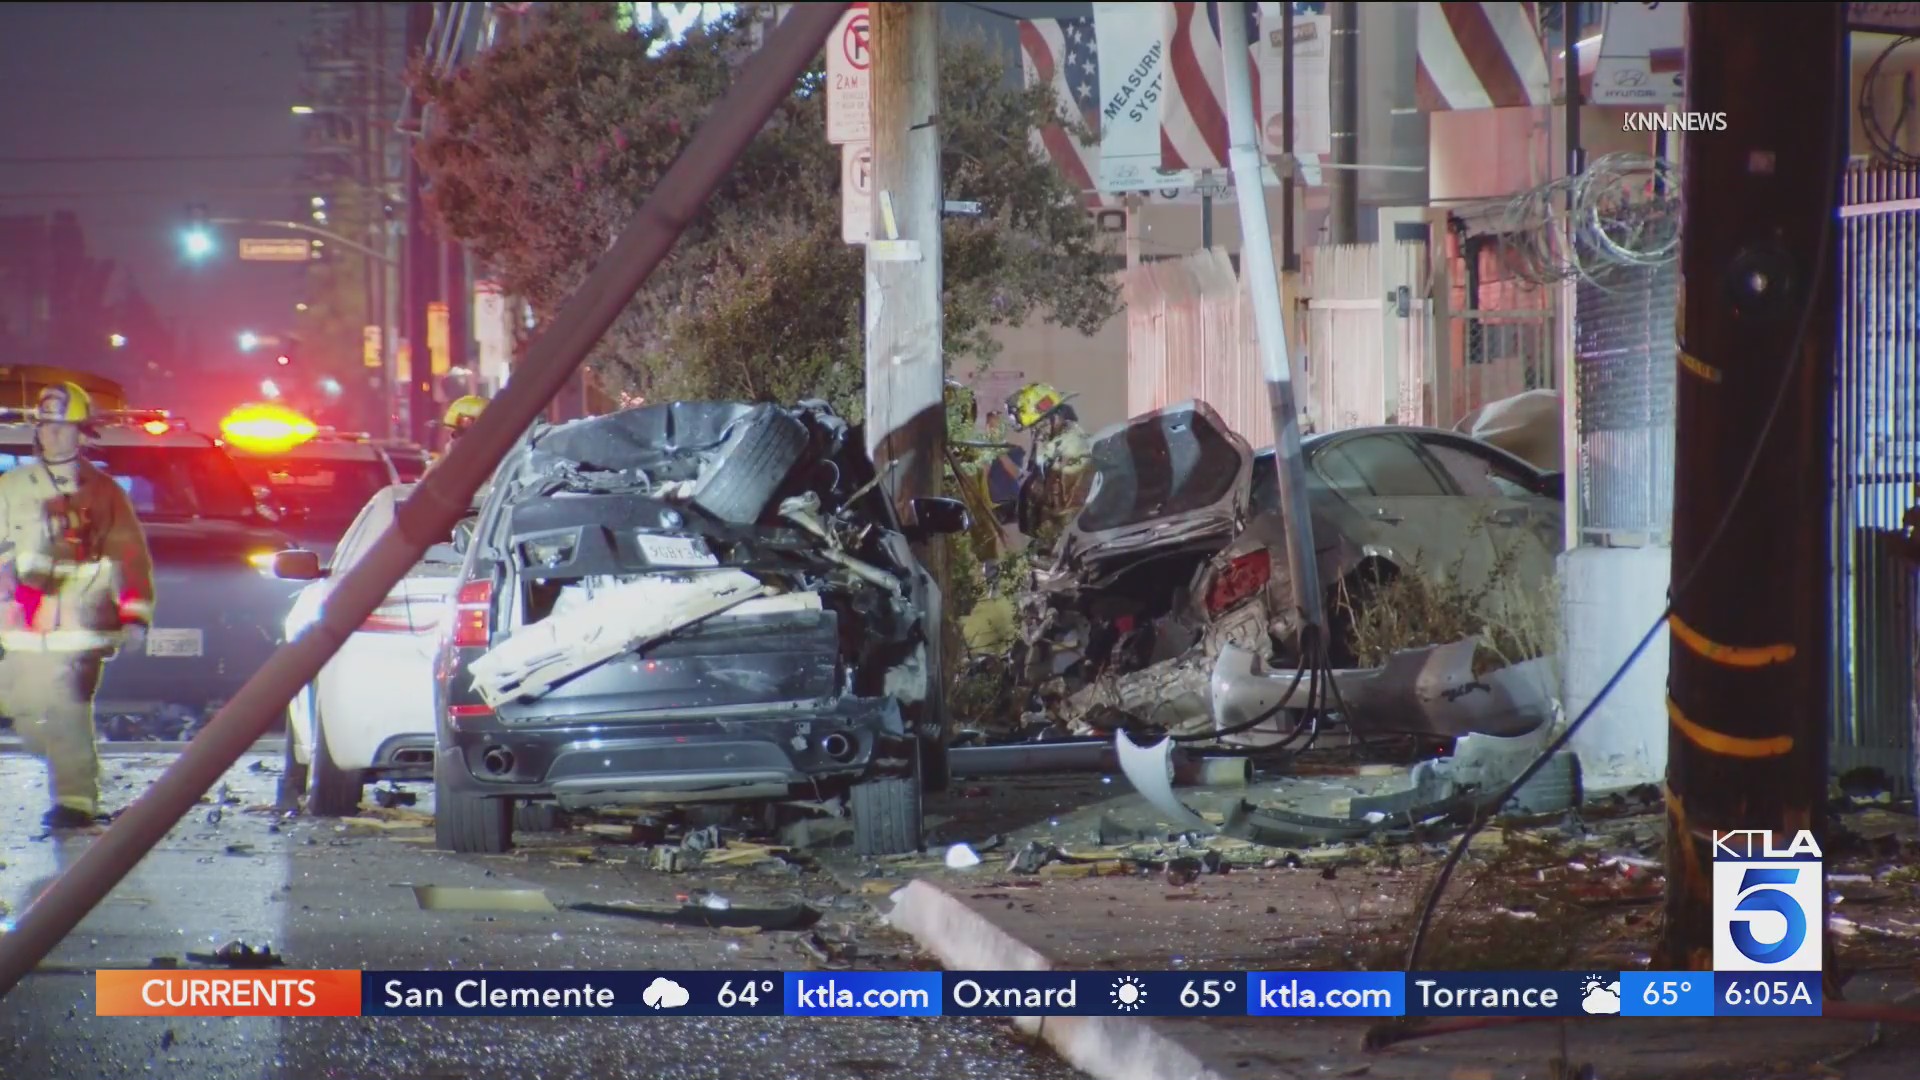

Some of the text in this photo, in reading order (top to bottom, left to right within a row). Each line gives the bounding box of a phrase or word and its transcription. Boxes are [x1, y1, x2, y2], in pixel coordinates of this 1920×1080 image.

[836, 73, 858, 90] 2AM
[1129, 72, 1163, 122] SYST
[1605, 89, 1656, 98] HYUNDAI
